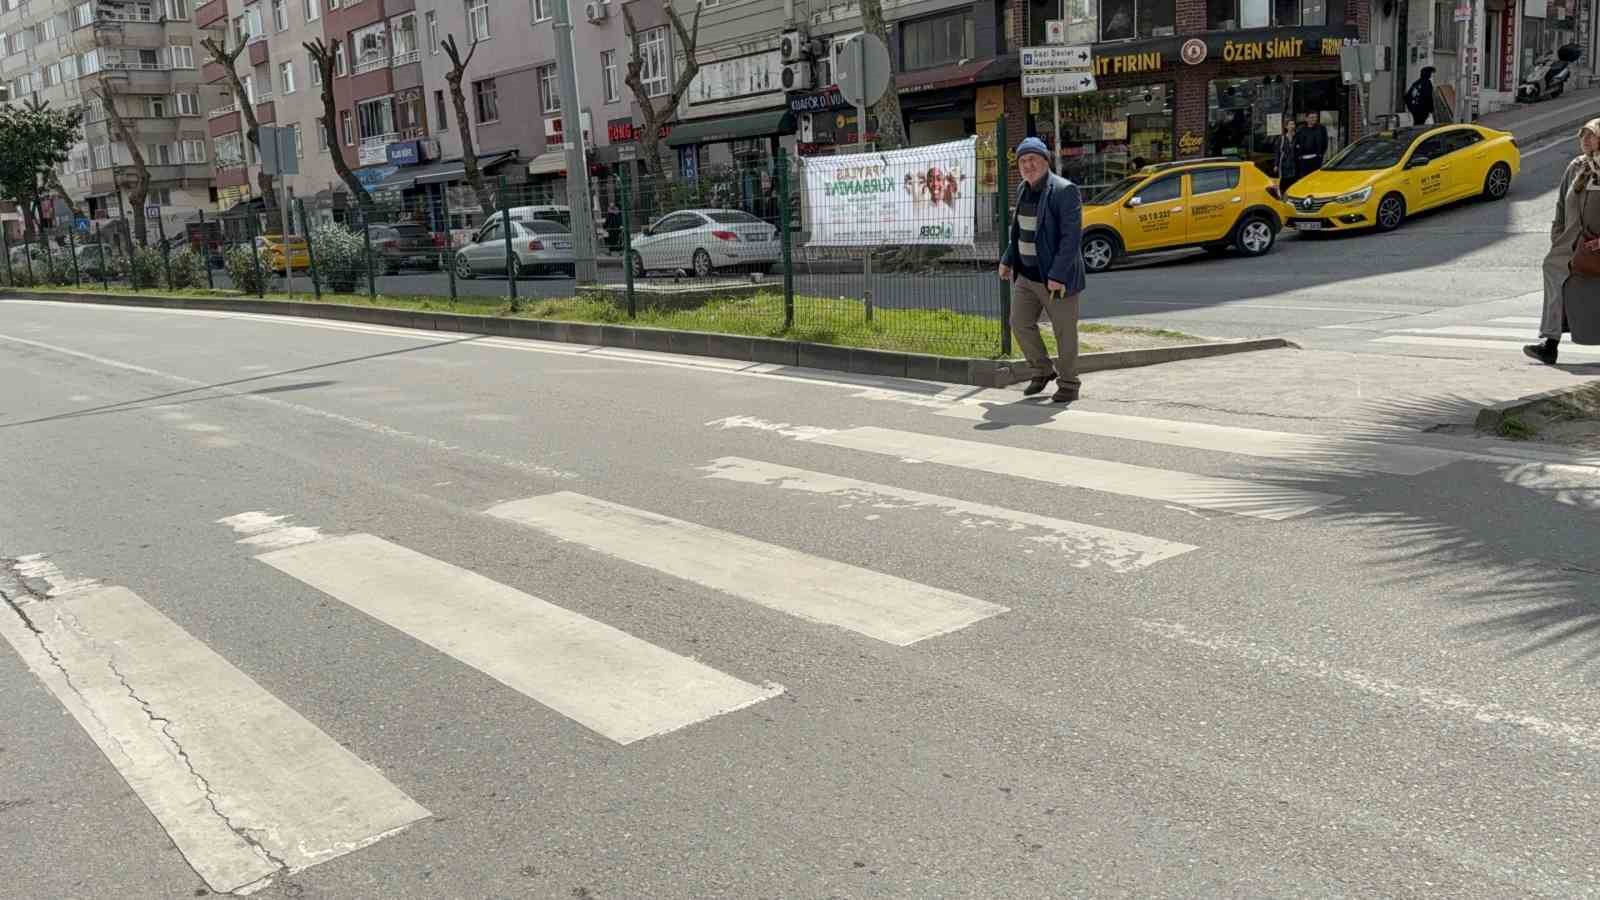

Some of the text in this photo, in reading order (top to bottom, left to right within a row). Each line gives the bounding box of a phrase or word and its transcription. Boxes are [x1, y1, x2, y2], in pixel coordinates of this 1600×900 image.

[1223, 40, 1262, 61] ÖZEN
[1266, 37, 1303, 58] SİMİT
[1114, 51, 1161, 74] FIRINI
